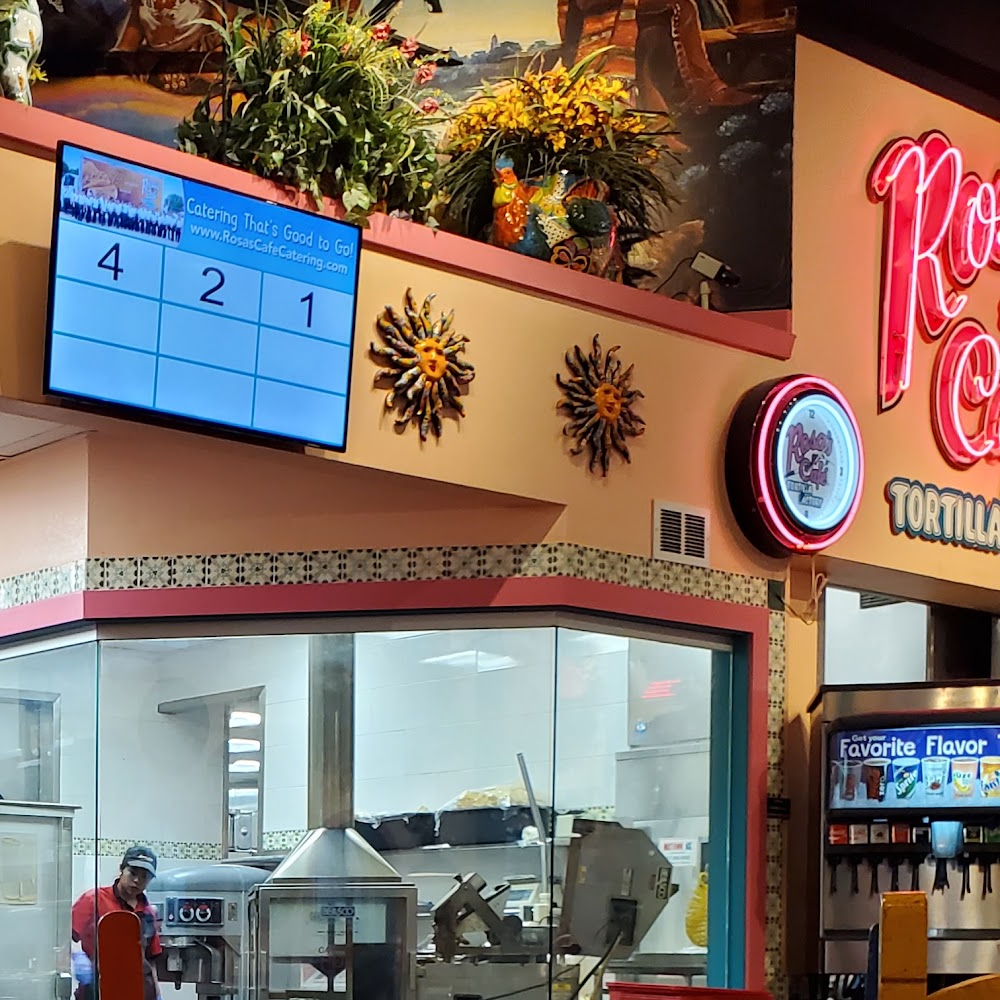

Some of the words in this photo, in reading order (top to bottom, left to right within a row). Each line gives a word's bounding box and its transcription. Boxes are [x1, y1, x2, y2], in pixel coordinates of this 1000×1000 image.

[186, 197, 238, 232] Catering
[244, 212, 279, 238] That's
[284, 224, 314, 247] Good
[318, 235, 330, 252] to
[334, 239, 354, 259] Go!
[190, 224, 349, 275] www.RosasCafeCatering.com
[97, 243, 124, 281] 4
[200, 267, 226, 306] 2
[300, 291, 315, 328] 1
[888, 480, 1000, 551] TORTILLA
[840, 736, 916, 758] Favorite
[926, 735, 988, 756] Flavor
[851, 734, 867, 742] Get
[868, 735, 887, 744] your
[895, 769, 918, 795] Sprite
